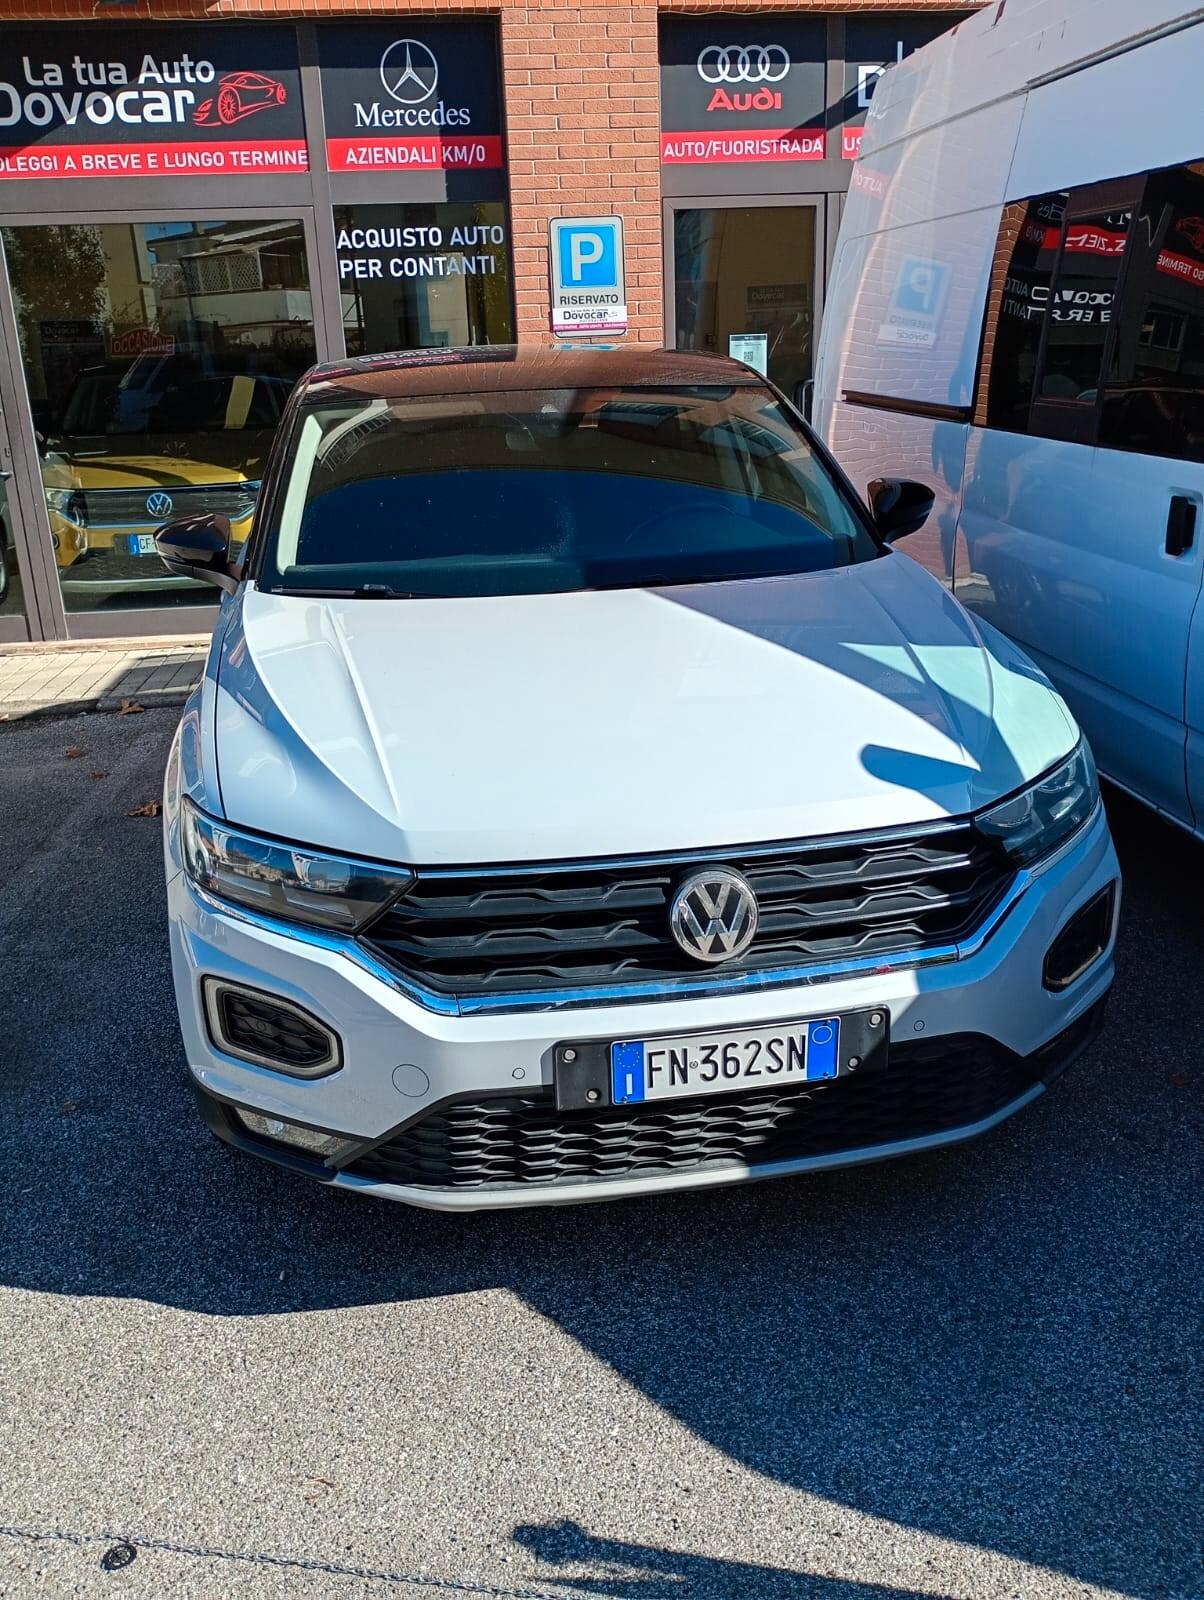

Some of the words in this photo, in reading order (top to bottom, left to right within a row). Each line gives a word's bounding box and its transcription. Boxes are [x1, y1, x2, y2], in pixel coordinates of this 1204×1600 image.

[22, 55, 63, 86] La
[72, 55, 128, 86] tua
[138, 53, 216, 85] Auto
[0, 81, 195, 126] Dovocar
[706, 87, 783, 112] Audi
[353, 100, 471, 127] Mercedes
[0, 155, 59, 172] LEGGI
[64, 155, 77, 171] A
[82, 153, 143, 170] BREVE
[147, 152, 158, 168] E
[164, 151, 225, 168] LUNGO
[229, 149, 308, 167] TERMINE
[346, 147, 437, 165] AZIENDALI
[442, 144, 486, 165] KM/0
[663, 138, 824, 159] AUTO/FUORISTRADA
[336, 226, 443, 250] ACQUISTO
[450, 225, 505, 246] AUTO
[340, 258, 384, 279] PER
[390, 255, 496, 277] CONTANTI
[570, 232, 604, 281] P
[559, 294, 619, 305] RISERVATO
[563, 310, 609, 320] Dovocar
[673, 873, 757, 960] VW
